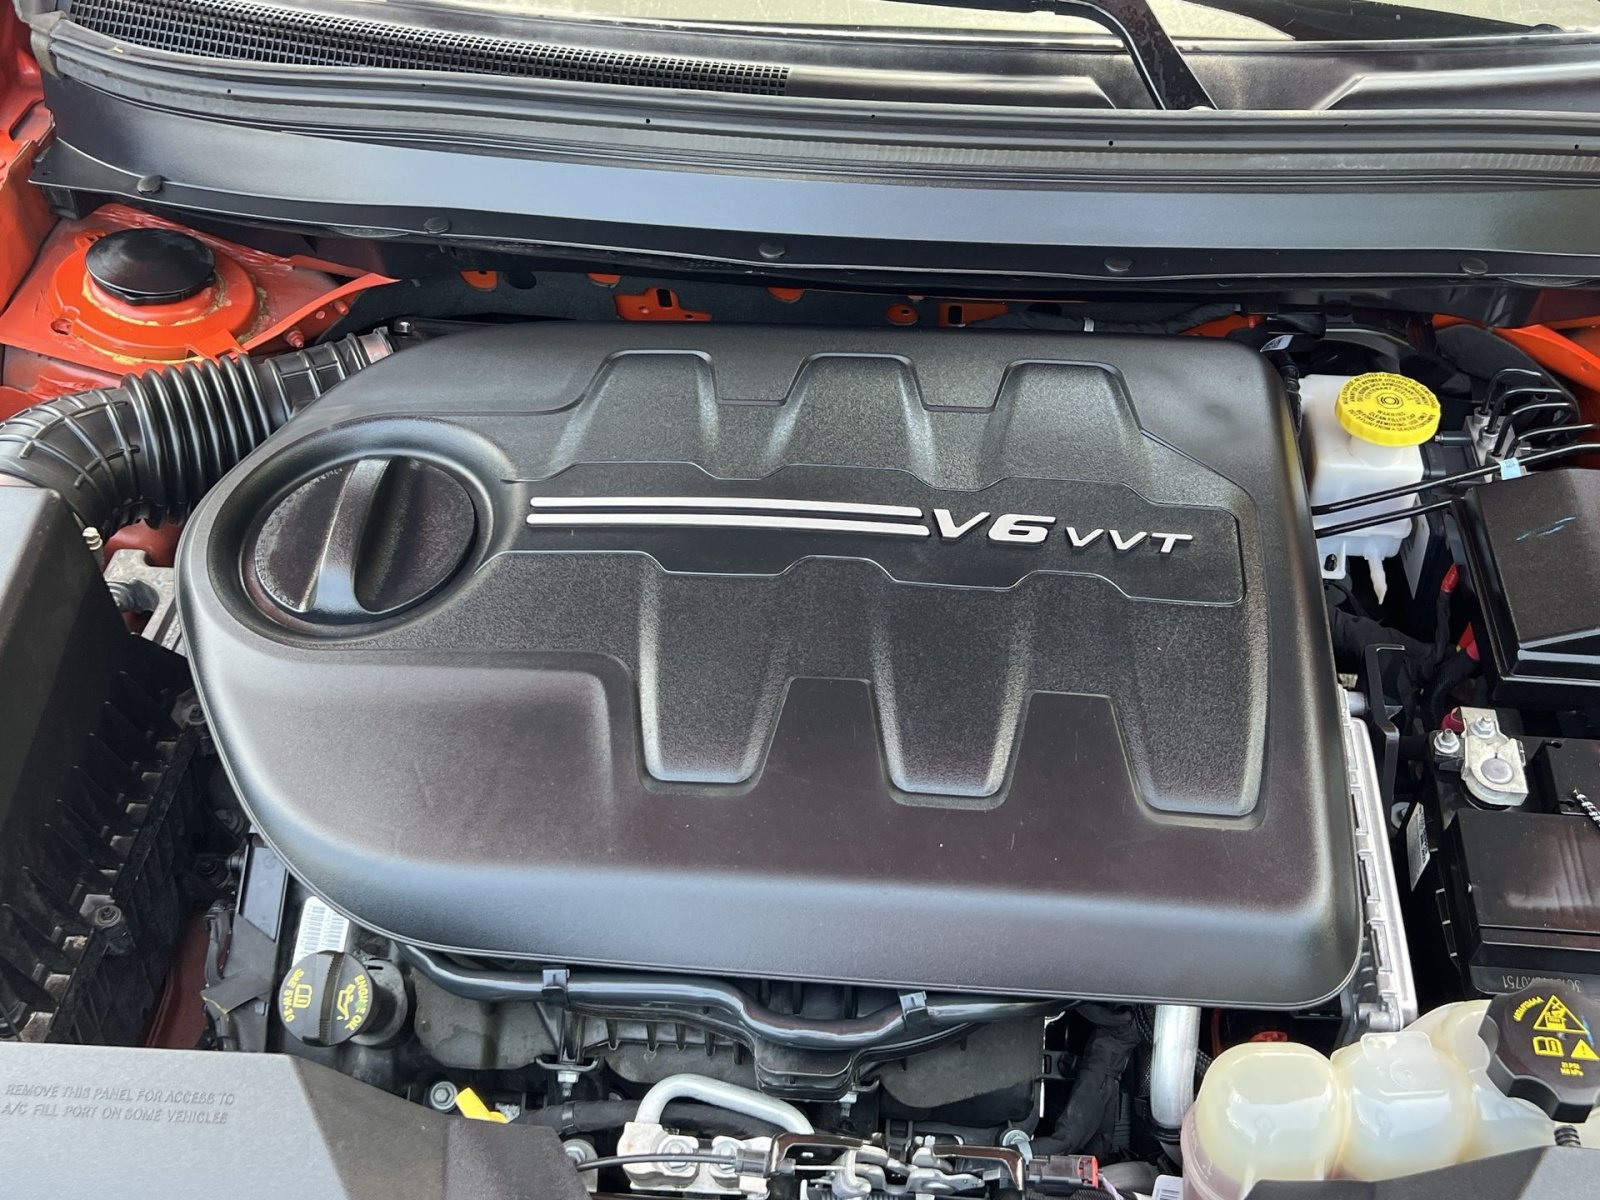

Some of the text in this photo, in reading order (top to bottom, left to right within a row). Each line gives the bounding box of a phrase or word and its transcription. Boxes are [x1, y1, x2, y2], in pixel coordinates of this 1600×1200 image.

[933, 508, 1194, 554] V6 VVT
[287, 968, 304, 988] SAE
[344, 974, 369, 1031] ENGINE OIL
[5, 1084, 235, 1106] REMOVE THIS PANEL FOR ACCESS TO
[1, 1101, 229, 1125] A/C FILL PORT ON SOME VEHICLES
